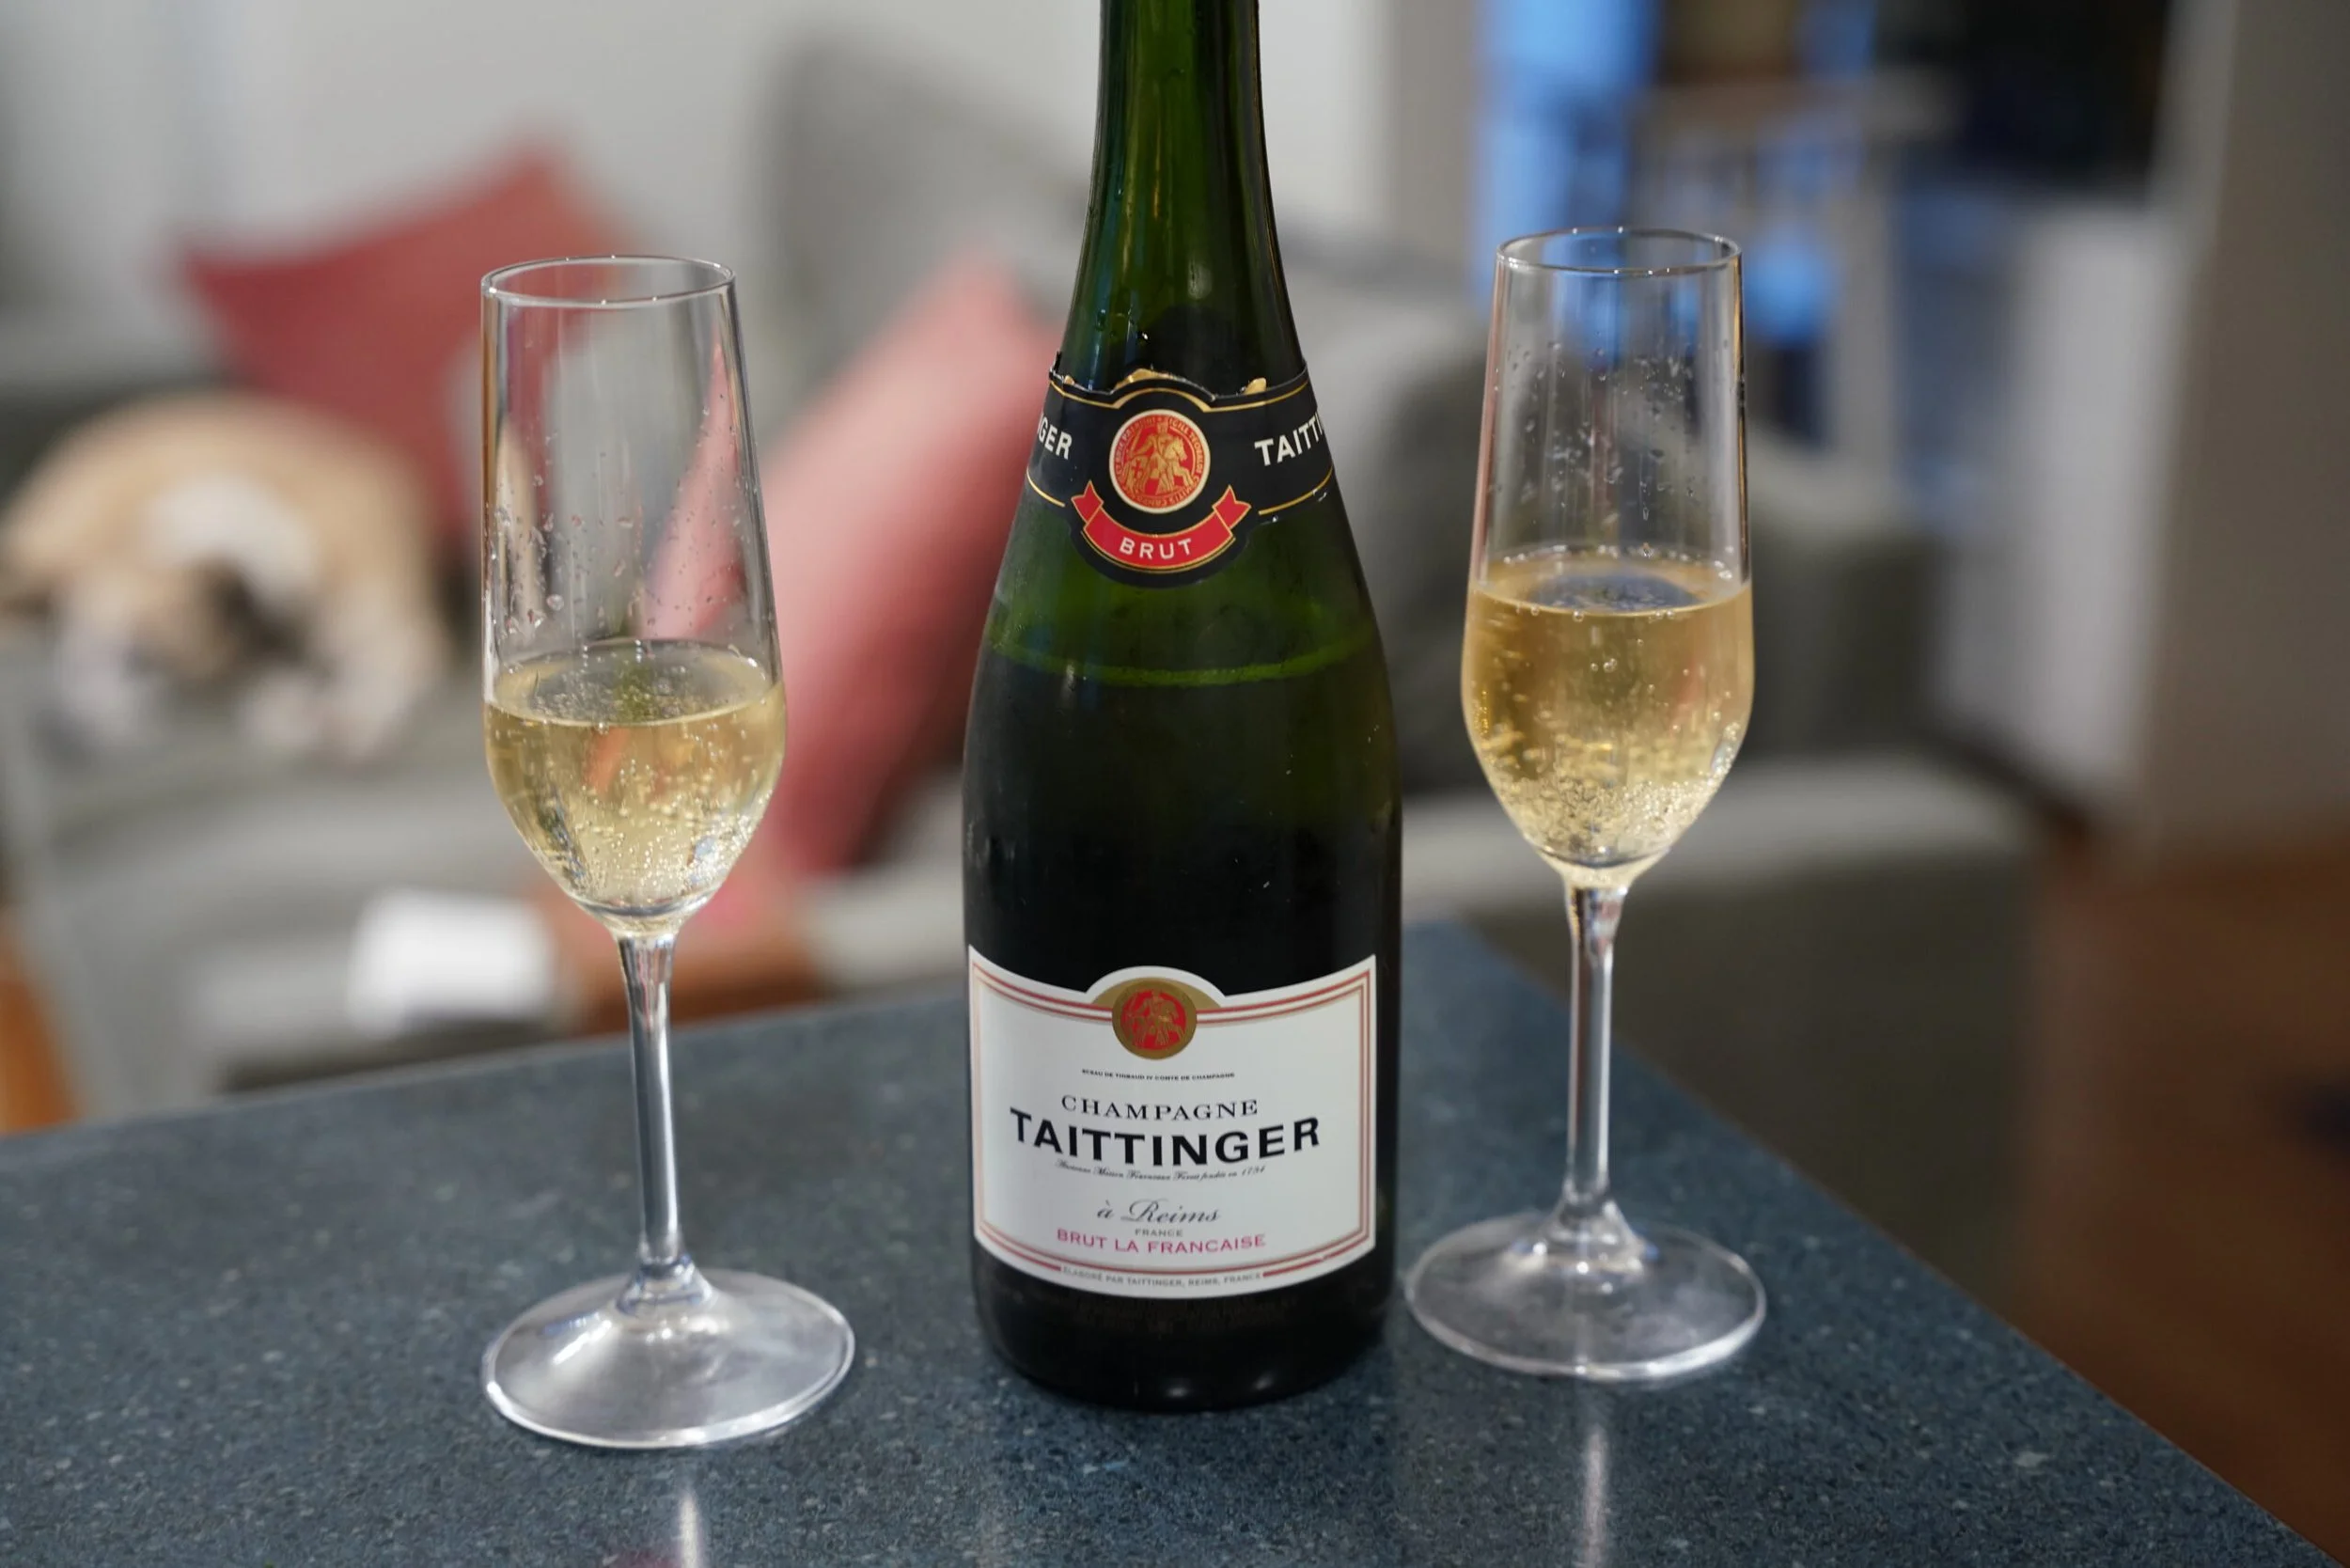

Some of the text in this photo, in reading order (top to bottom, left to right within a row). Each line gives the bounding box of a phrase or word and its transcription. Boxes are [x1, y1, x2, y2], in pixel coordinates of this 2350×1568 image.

[1037, 412, 1073, 461] GER
[1119, 537, 1192, 560] BRUT
[1061, 1094, 1259, 1121] CHAMPAGNE
[1010, 1106, 1320, 1168] TAITTINGER
[1096, 1198, 1220, 1223] à Reims
[1057, 1228, 1266, 1254] BRUT LA FRANCAISE
[1135, 1228, 1183, 1237] FRANCE
[1105, 1275, 1123, 1284] PAR
[1127, 1277, 1185, 1288] TAITTINGER,
[1223, 1273, 1261, 1284] FRANCE
